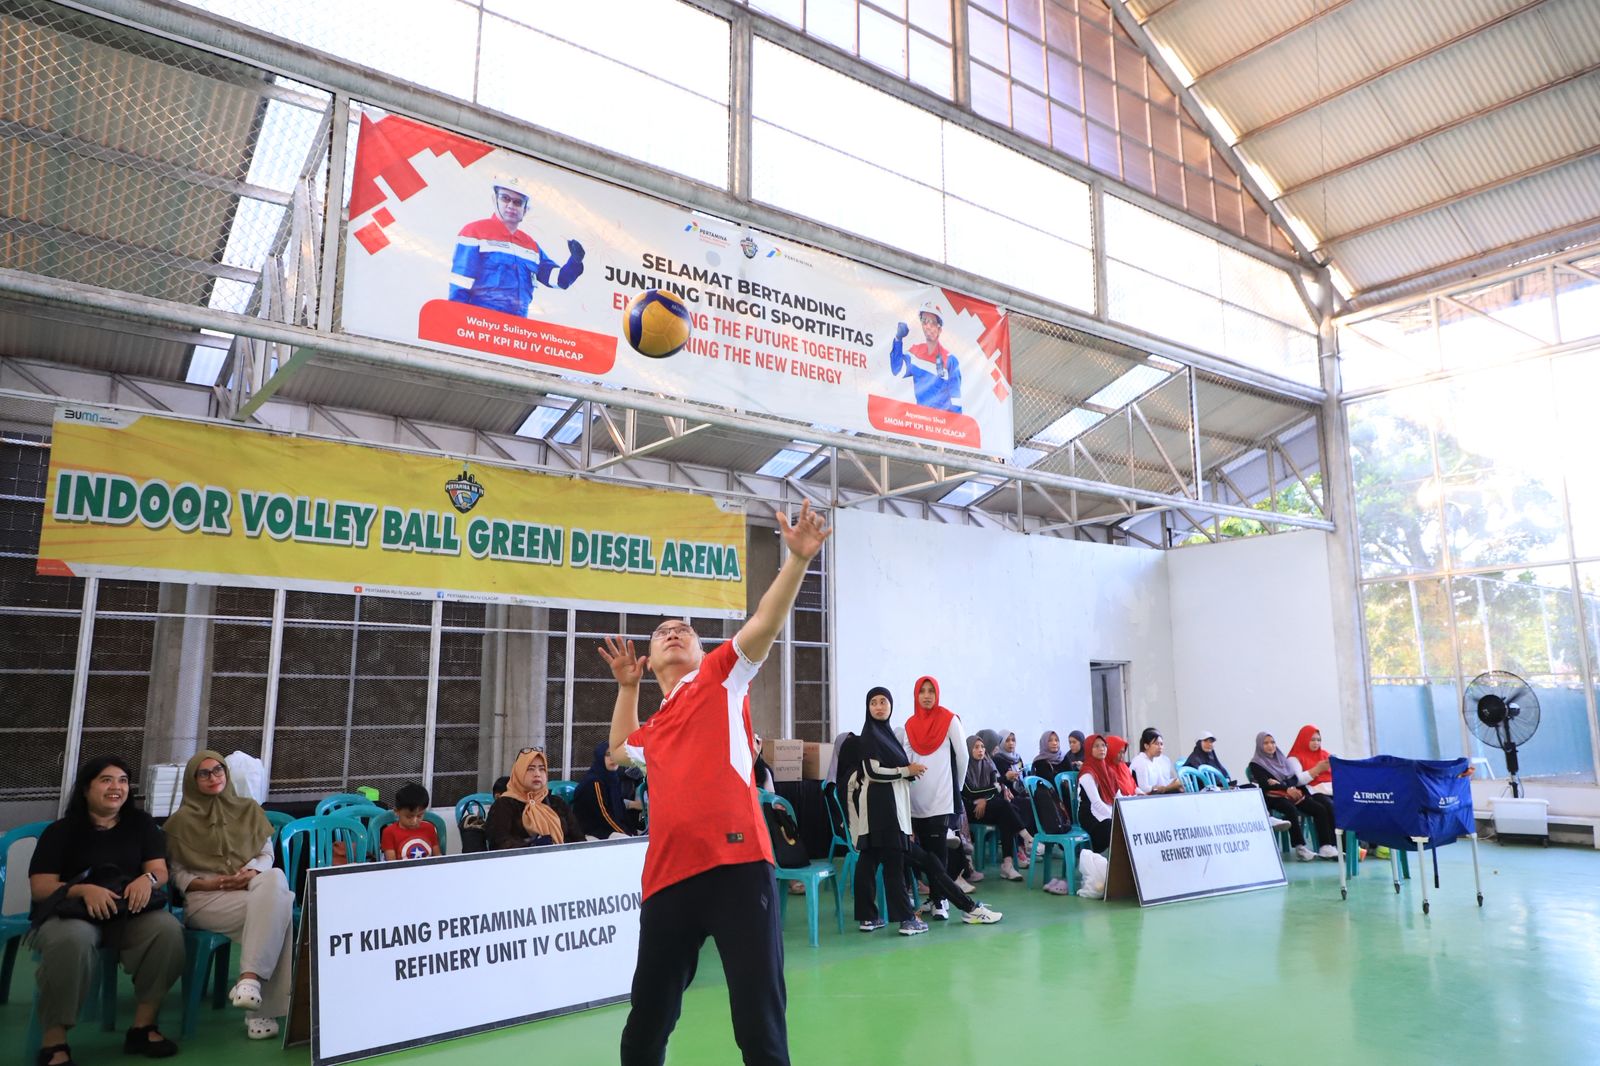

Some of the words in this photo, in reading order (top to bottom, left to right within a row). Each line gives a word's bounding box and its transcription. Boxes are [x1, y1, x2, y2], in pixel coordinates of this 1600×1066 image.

[605, 265, 699, 303] JUNJUNG
[705, 291, 766, 319] TINGGI
[771, 310, 874, 347] SPORTIFITAS
[642, 252, 733, 290] SELAMAT
[738, 279, 846, 321] BERTANDING
[456, 328, 476, 340] GM
[478, 332, 490, 344] PT
[493, 335, 510, 348] KPI
[513, 338, 528, 350] RU
[530, 342, 542, 353] IV
[544, 344, 584, 362] CILACAP
[466, 316, 500, 332] Wahyu
[503, 322, 538, 340] Sulistyo
[540, 330, 576, 347] Wibowo
[713, 317, 740, 338] THE
[746, 325, 798, 351] FUTURE
[802, 338, 867, 368] TOGETHER
[723, 344, 750, 364] THE
[756, 352, 787, 372] NEW
[791, 360, 842, 385] ENERGY
[55, 472, 231, 531] INDOOR
[239, 491, 377, 544] VOLLEY
[382, 507, 459, 552] BALL
[467, 518, 562, 563] GREEN
[571, 530, 654, 571] DIESEL
[660, 540, 740, 578] ARENA
[1361, 792, 1391, 800] TRINITY
[1133, 833, 1142, 847] PT
[1144, 829, 1172, 845] KILANG
[1174, 826, 1213, 842] PERTAMINA
[1214, 820, 1266, 838] INTERNASIONAL
[1161, 847, 1194, 862] REFINERY
[1197, 844, 1212, 858] UNIT
[1214, 844, 1221, 856] IV
[1222, 840, 1250, 856] CILACAP
[330, 933, 352, 956] PT
[360, 922, 431, 952] KILANG
[438, 907, 537, 941] PERTAMINA
[542, 892, 642, 922] INTERNASION
[395, 946, 480, 981] REFINERY
[486, 939, 527, 964] UNIT
[532, 936, 550, 956] IV
[555, 925, 617, 954] CILACAP
